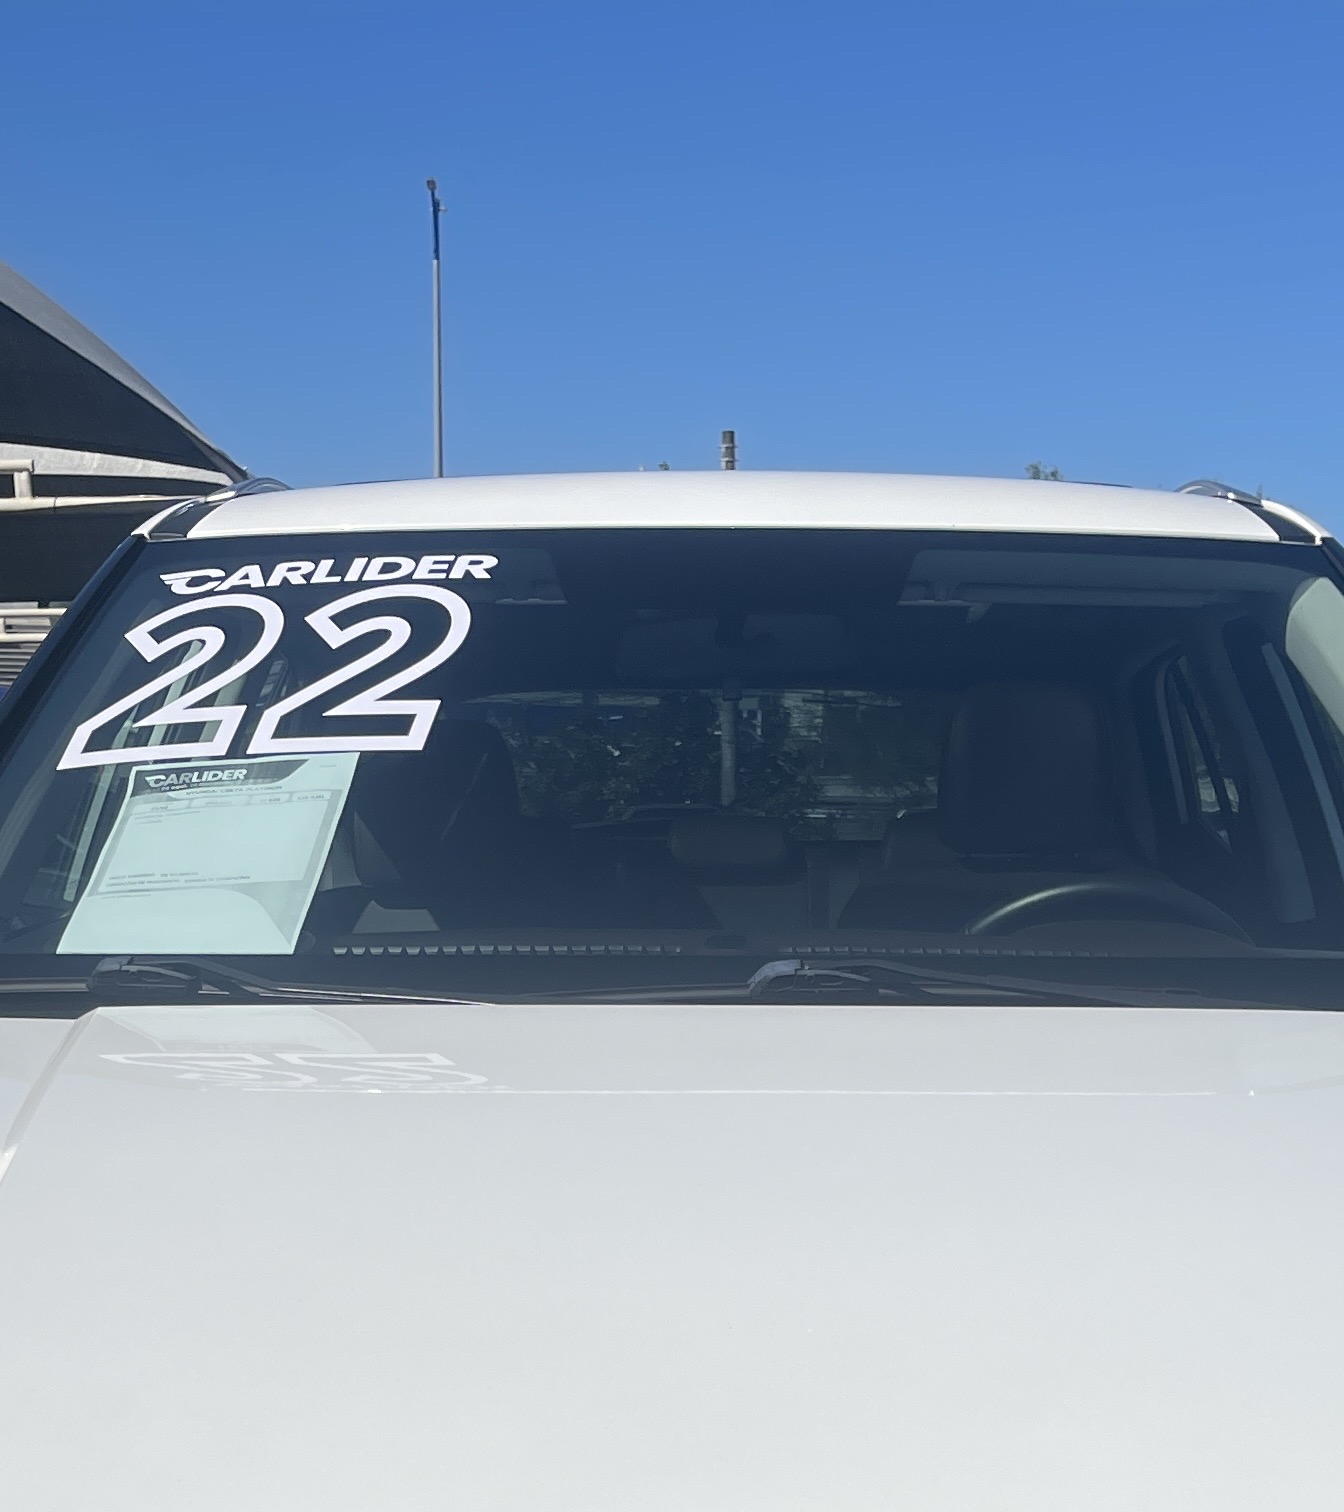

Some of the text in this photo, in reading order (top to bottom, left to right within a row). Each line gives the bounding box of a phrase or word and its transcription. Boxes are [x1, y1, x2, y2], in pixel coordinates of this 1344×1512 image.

[160, 555, 499, 594] CARLIDER
[57, 584, 471, 770] 22
[144, 769, 248, 788] CARLIDER
